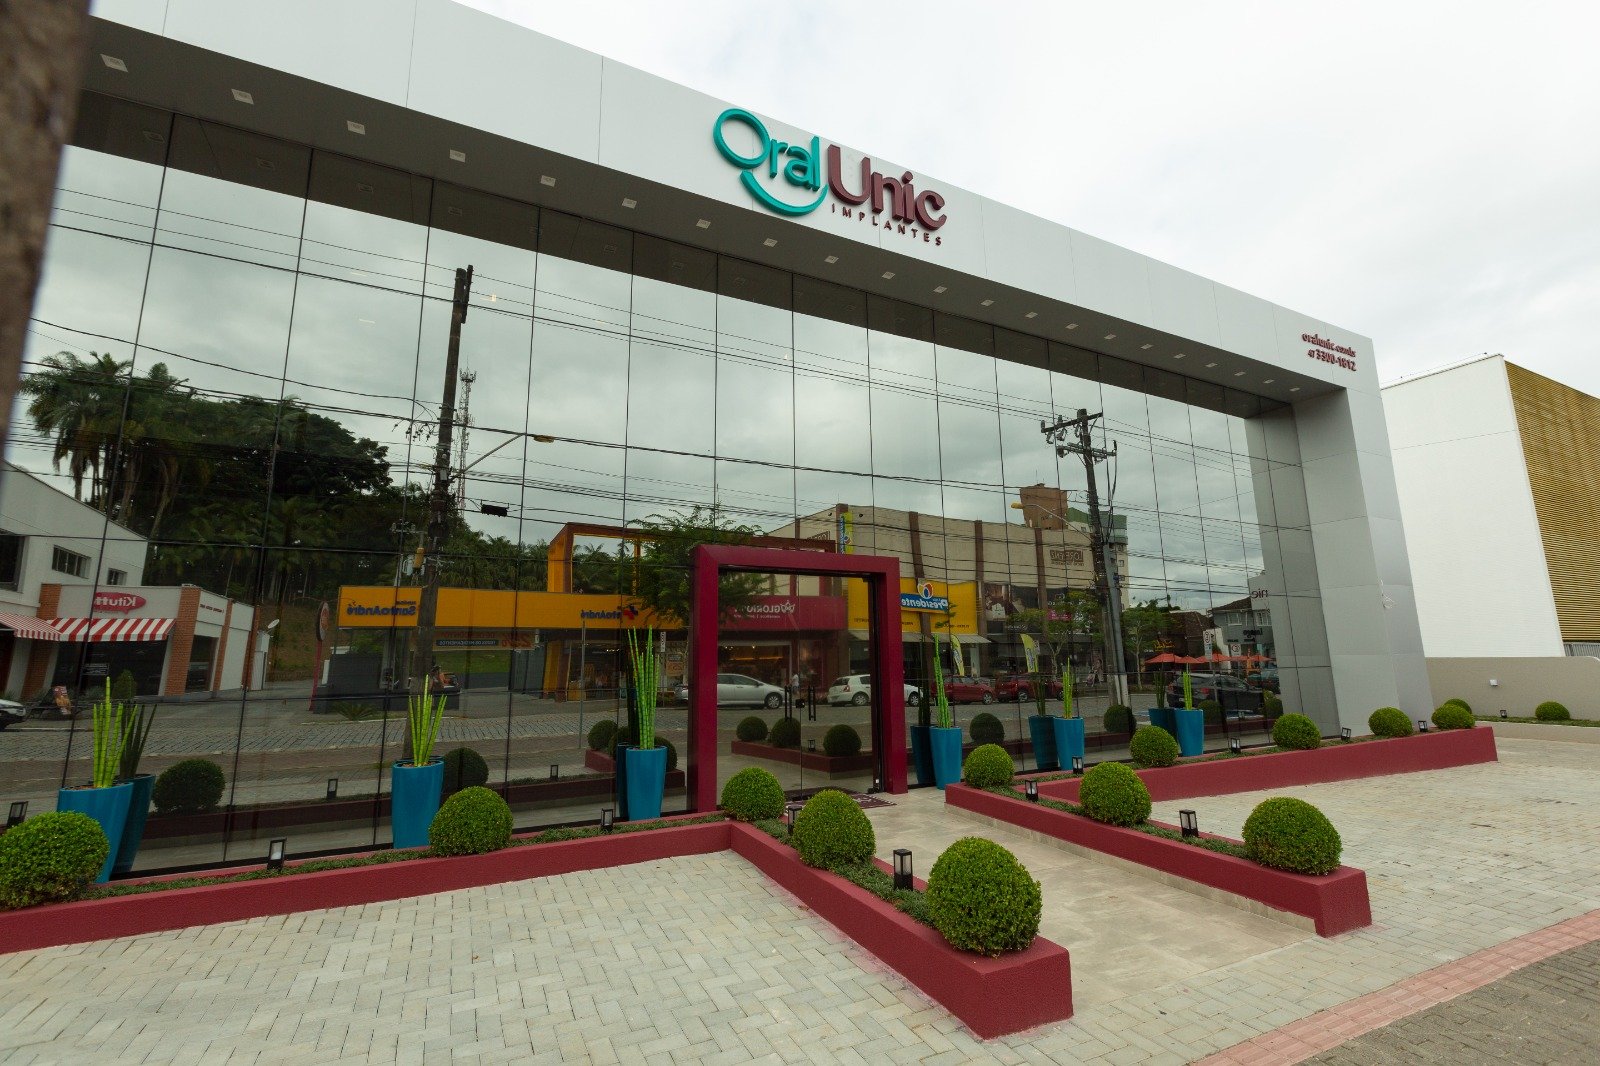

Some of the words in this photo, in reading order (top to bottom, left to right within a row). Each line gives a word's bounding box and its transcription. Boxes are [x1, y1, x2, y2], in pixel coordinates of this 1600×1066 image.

[713, 108, 822, 194] Oral
[827, 144, 947, 231] Unic
[831, 203, 943, 246] IMPLANTES
